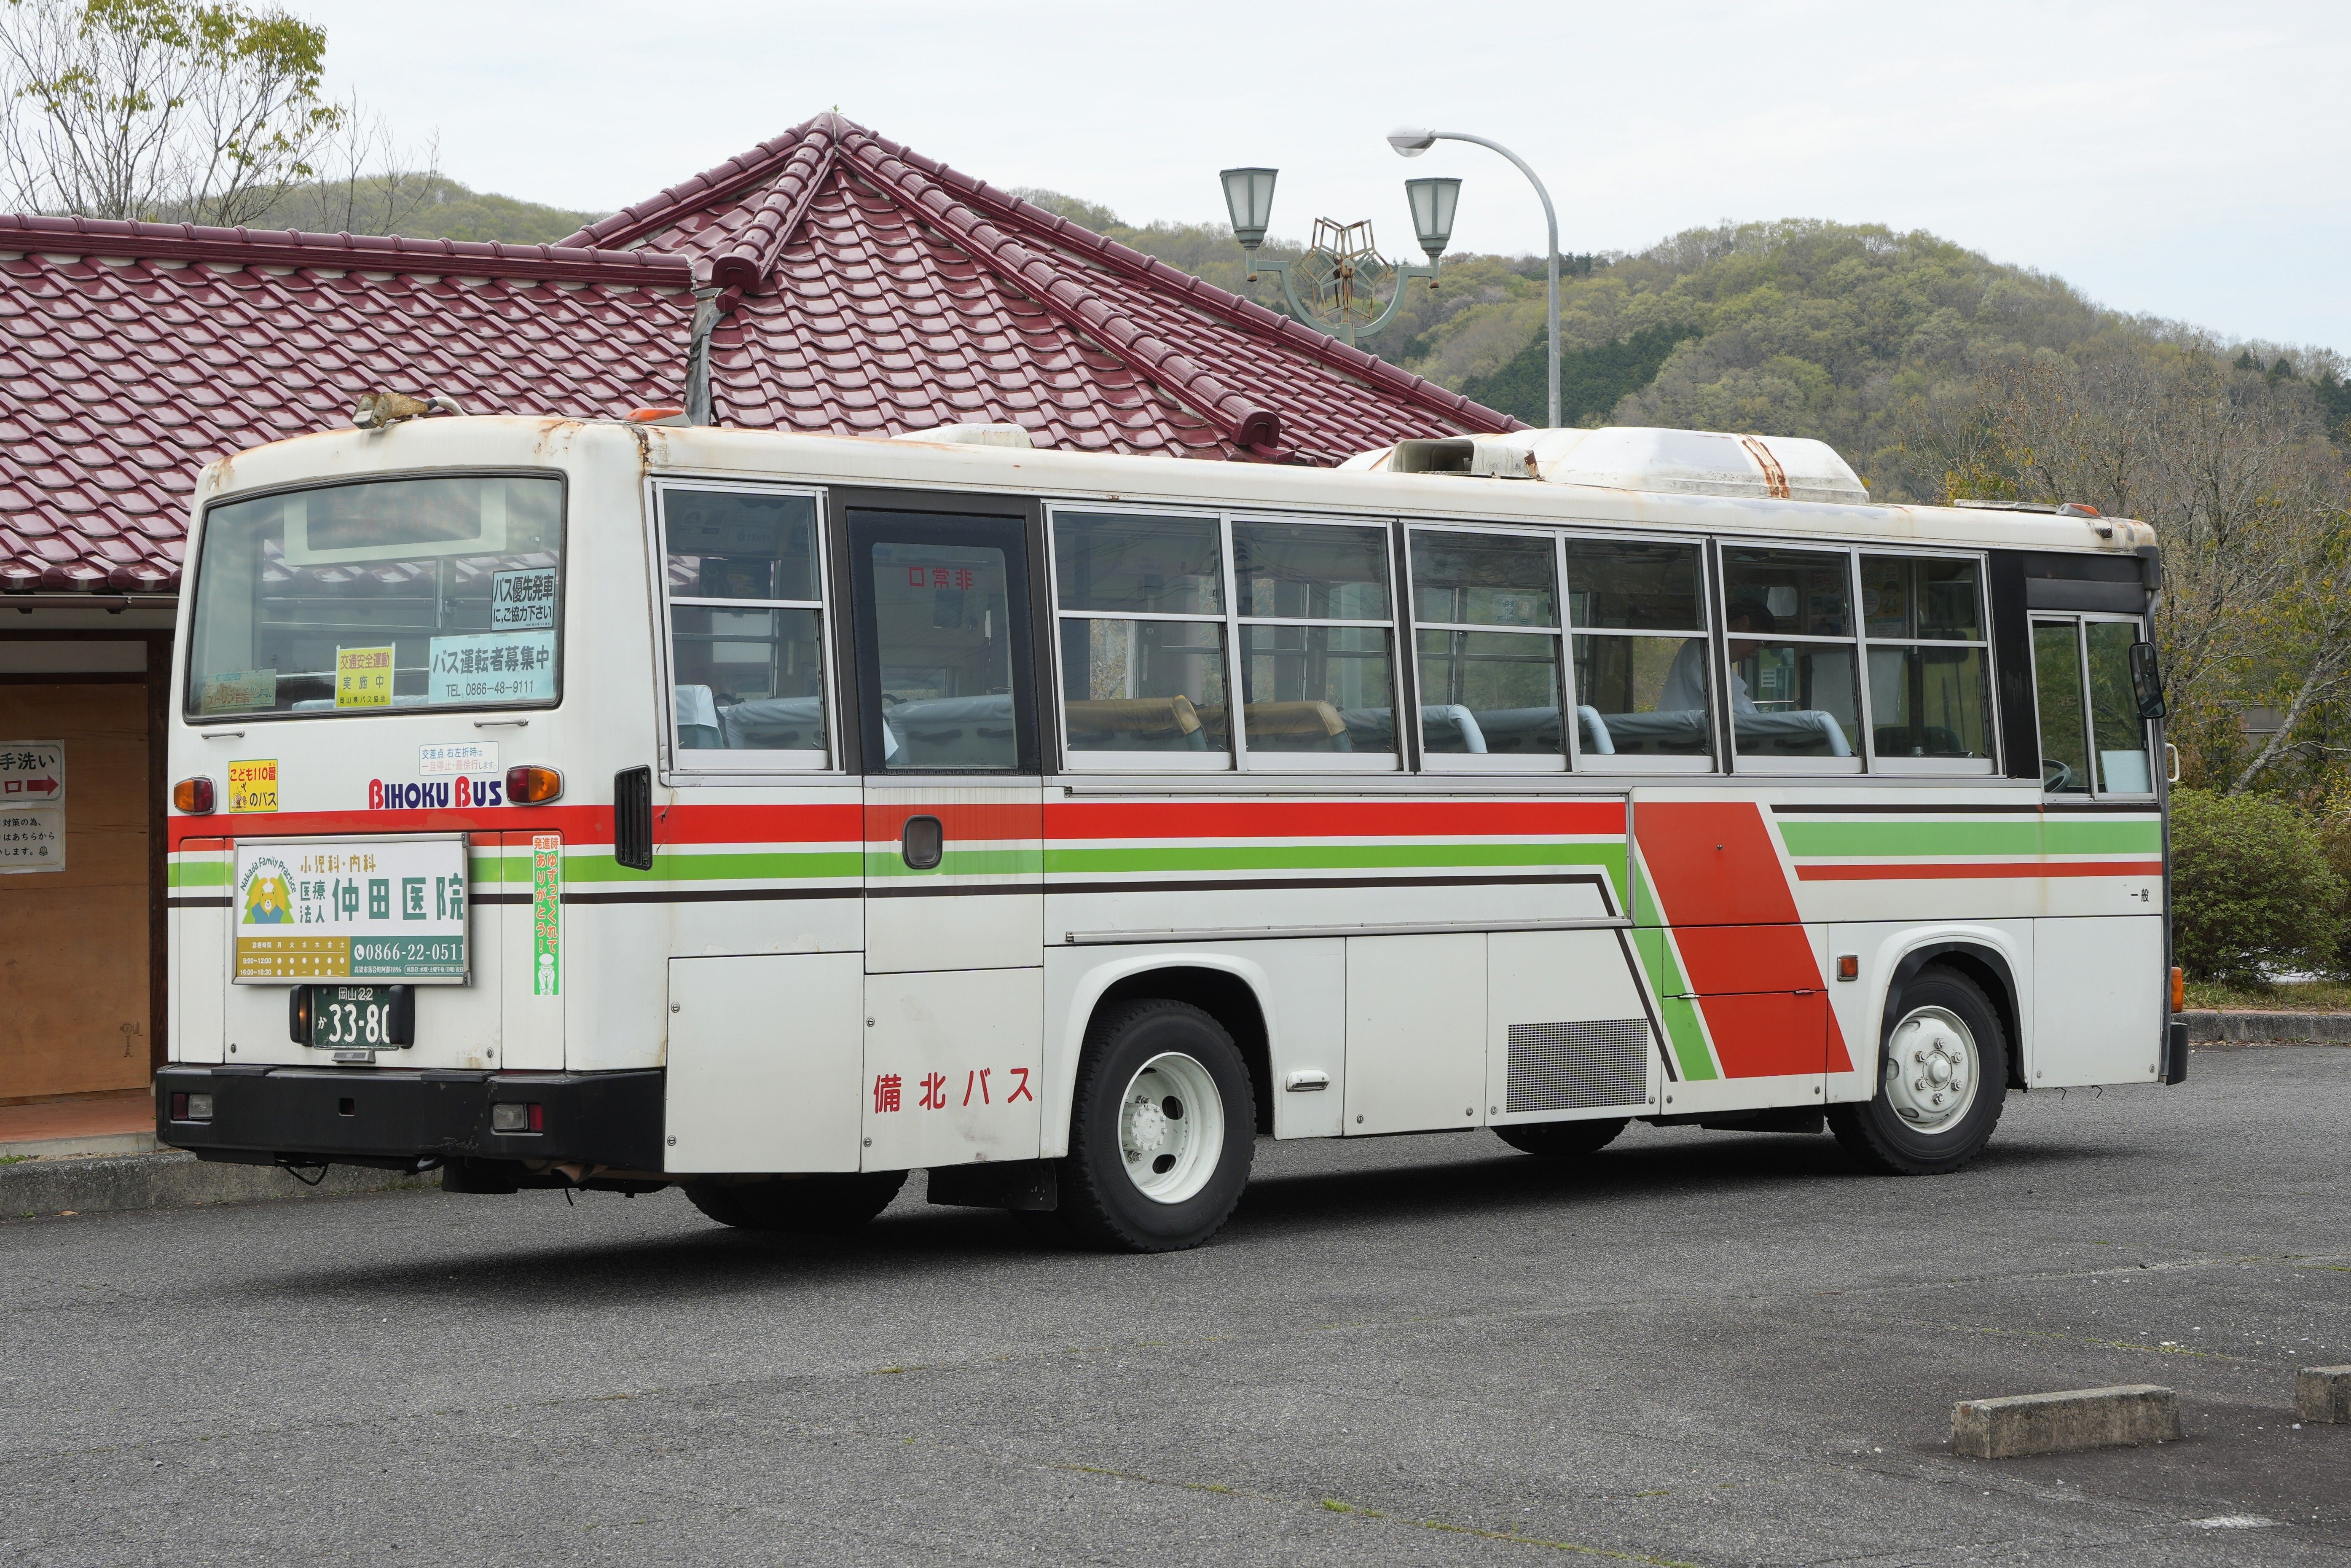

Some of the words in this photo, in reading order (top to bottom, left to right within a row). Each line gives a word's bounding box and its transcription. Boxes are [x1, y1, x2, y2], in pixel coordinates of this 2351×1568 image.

[494, 574, 554, 603] バス優先発車
[340, 652, 389, 669] 交通安全運動
[432, 644, 549, 674] バス運転者募集中
[343, 675, 384, 690] 実施中
[466, 680, 533, 696] 0866-48-9111
[339, 695, 386, 704] 岡山県バス協会
[0, 752, 54, 770] 手洗い
[422, 748, 444, 759] 交差点
[447, 746, 483, 758] 右左折時は
[230, 766, 276, 781] こども110番
[250, 792, 276, 807] のバス
[369, 779, 449, 809] BIHOKU
[455, 776, 502, 807] BUS
[0, 818, 41, 827] 対策の為、
[0, 832, 55, 841] はあちらから
[534, 837, 558, 850] 発進時
[240, 862, 259, 891] Nakada
[258, 856, 278, 868] Family
[278, 860, 297, 893] Practice
[300, 879, 326, 901] 医療
[332, 872, 463, 921] 仲田医院
[2131, 888, 2149, 902] 一般
[547, 853, 558, 953] ゆずってくれて
[300, 905, 325, 924] 法人
[366, 942, 464, 961] 0866-22-0511
[338, 987, 373, 1001] 岡山22
[873, 1067, 1033, 1114] 備北バス
